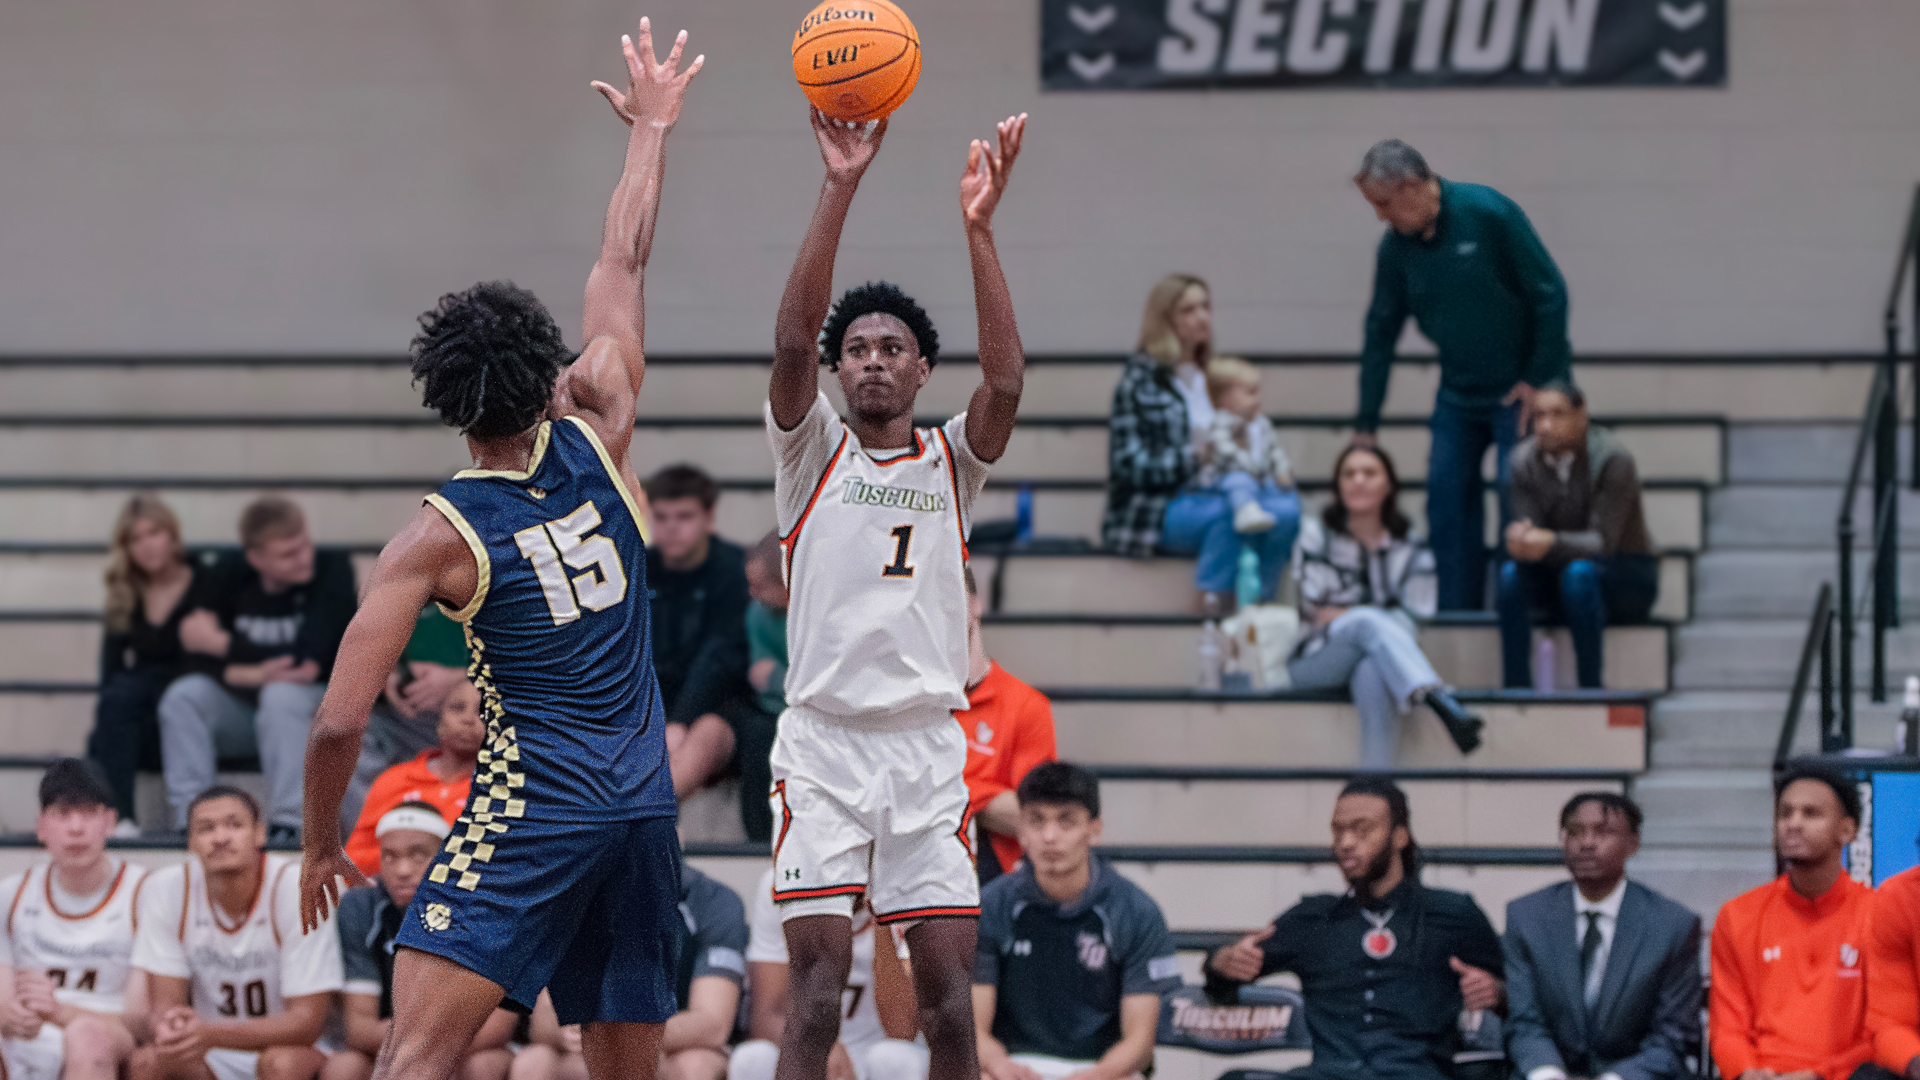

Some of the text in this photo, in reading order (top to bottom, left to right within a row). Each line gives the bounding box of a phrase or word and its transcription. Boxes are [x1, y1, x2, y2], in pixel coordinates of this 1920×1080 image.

[1157, 0, 1599, 73] SECTION
[513, 500, 628, 626] 15
[882, 524, 914, 577] 1
[217, 979, 267, 1017] 30
